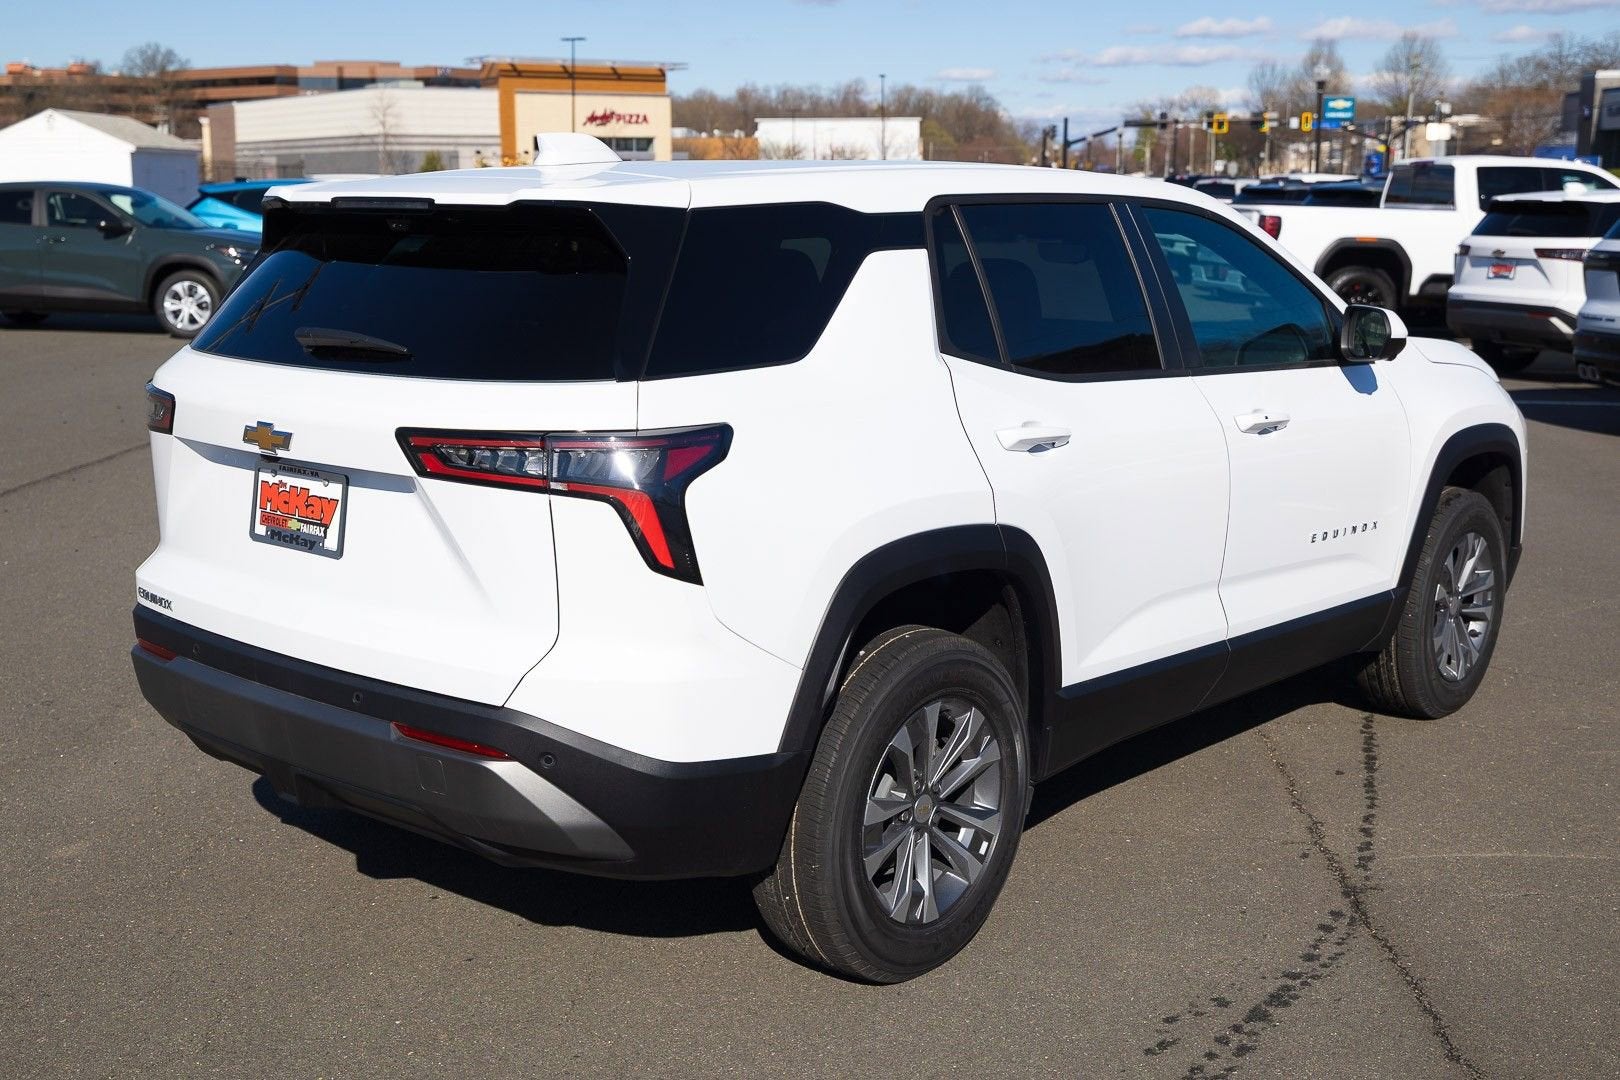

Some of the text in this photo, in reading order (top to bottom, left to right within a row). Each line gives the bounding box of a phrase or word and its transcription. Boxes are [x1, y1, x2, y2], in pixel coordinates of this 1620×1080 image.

[614, 113, 649, 124] PIZZA
[260, 480, 339, 528] McKay
[261, 514, 325, 537] CHEVROLET FAIRFAX
[1311, 521, 1378, 543] EQUINOX
[270, 530, 316, 550] McKay
